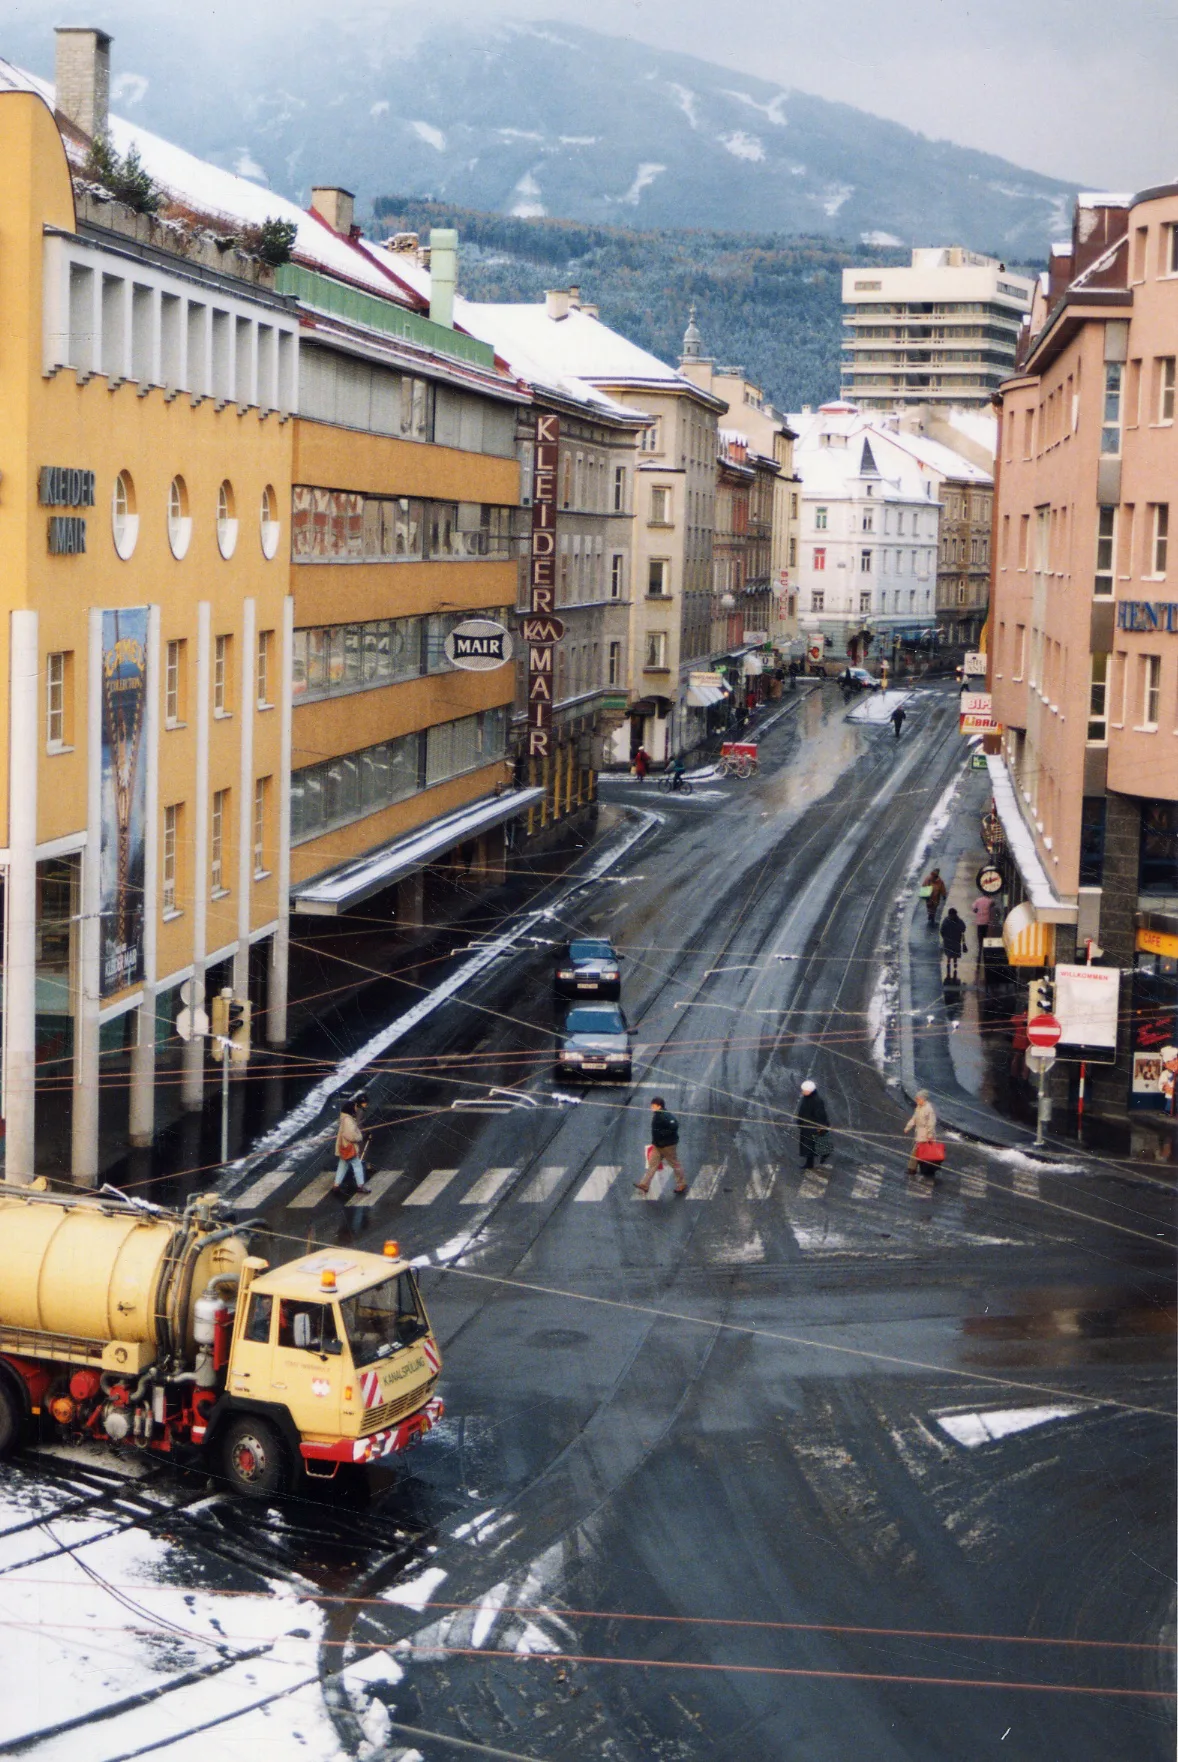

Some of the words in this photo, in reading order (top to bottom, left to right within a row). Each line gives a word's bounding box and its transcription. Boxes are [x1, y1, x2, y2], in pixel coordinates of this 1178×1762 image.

[41, 466, 96, 506] KLEIDER
[49, 516, 86, 553] MAIR
[532, 416, 555, 613] KLEIDER
[105, 638, 146, 678] CAMEL
[457, 638, 500, 655] MAIR
[529, 647, 553, 757] MAIR
[1060, 971, 1108, 981] WILLKOMMEN
